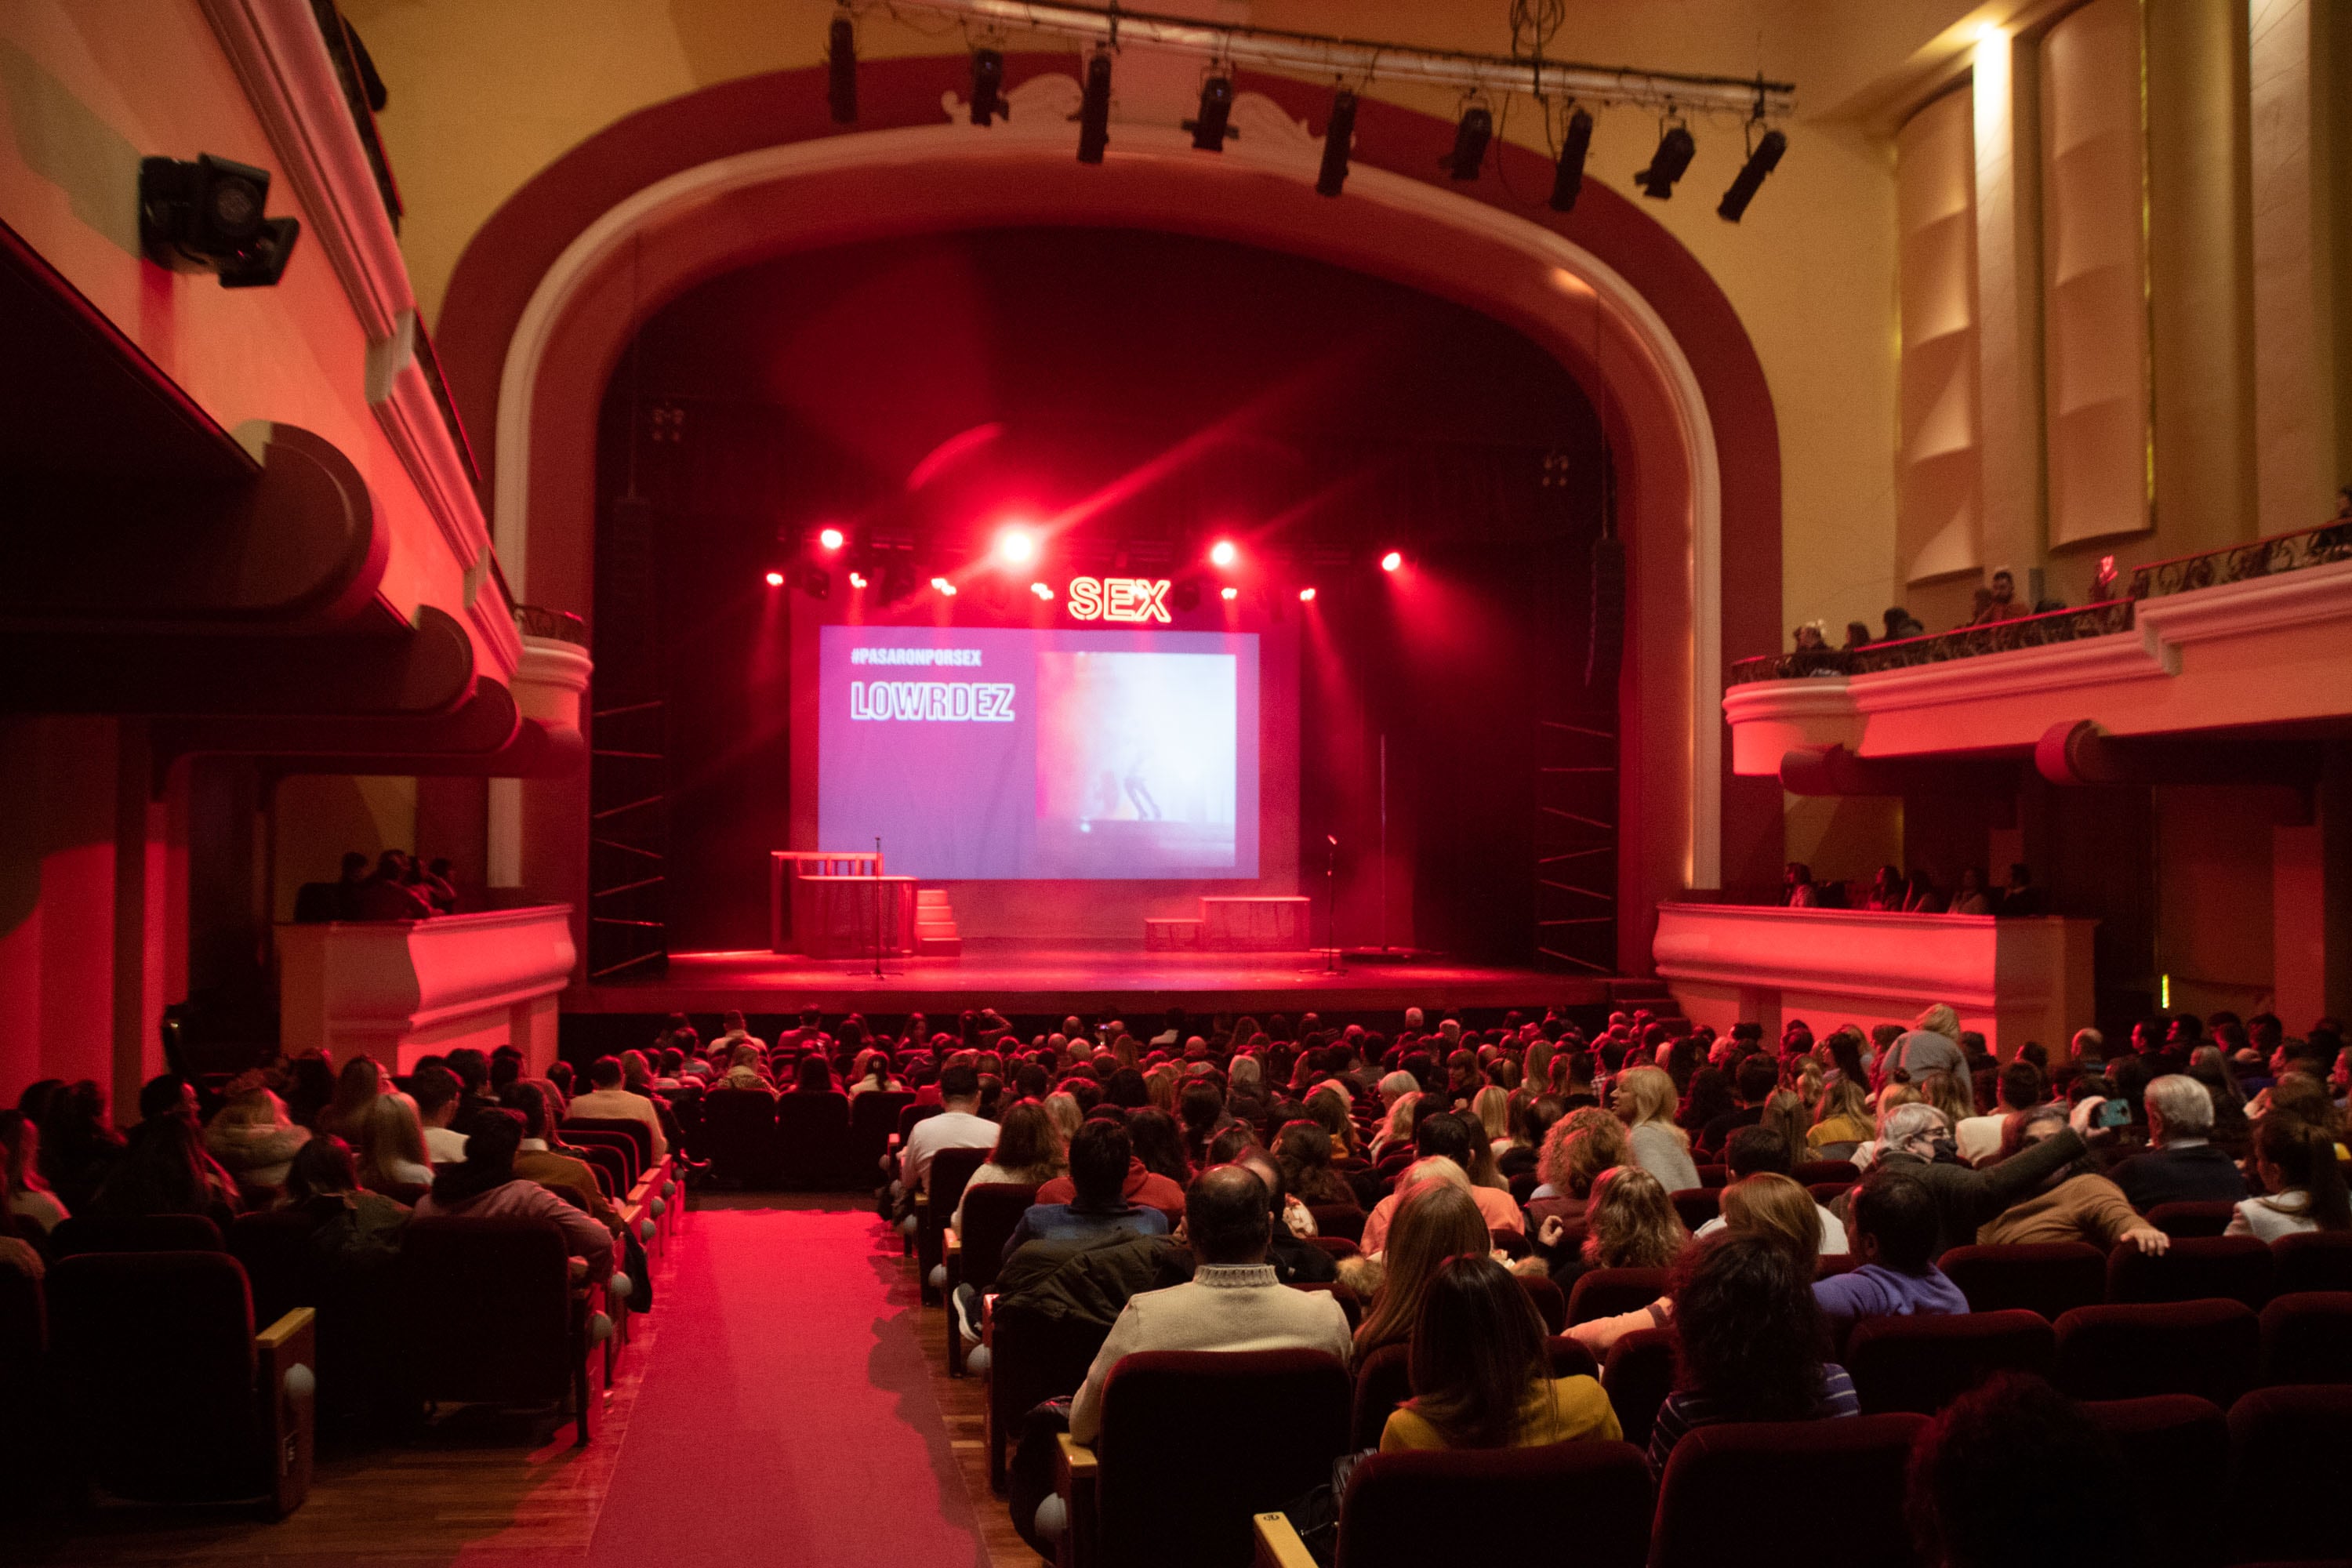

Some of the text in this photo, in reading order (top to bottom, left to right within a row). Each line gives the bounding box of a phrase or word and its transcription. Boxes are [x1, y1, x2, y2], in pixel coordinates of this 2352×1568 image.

[1069, 576, 1171, 622] SEX
[851, 648, 982, 666] #PASARONPORSEX
[851, 681, 1015, 722] LOWRDEZ
